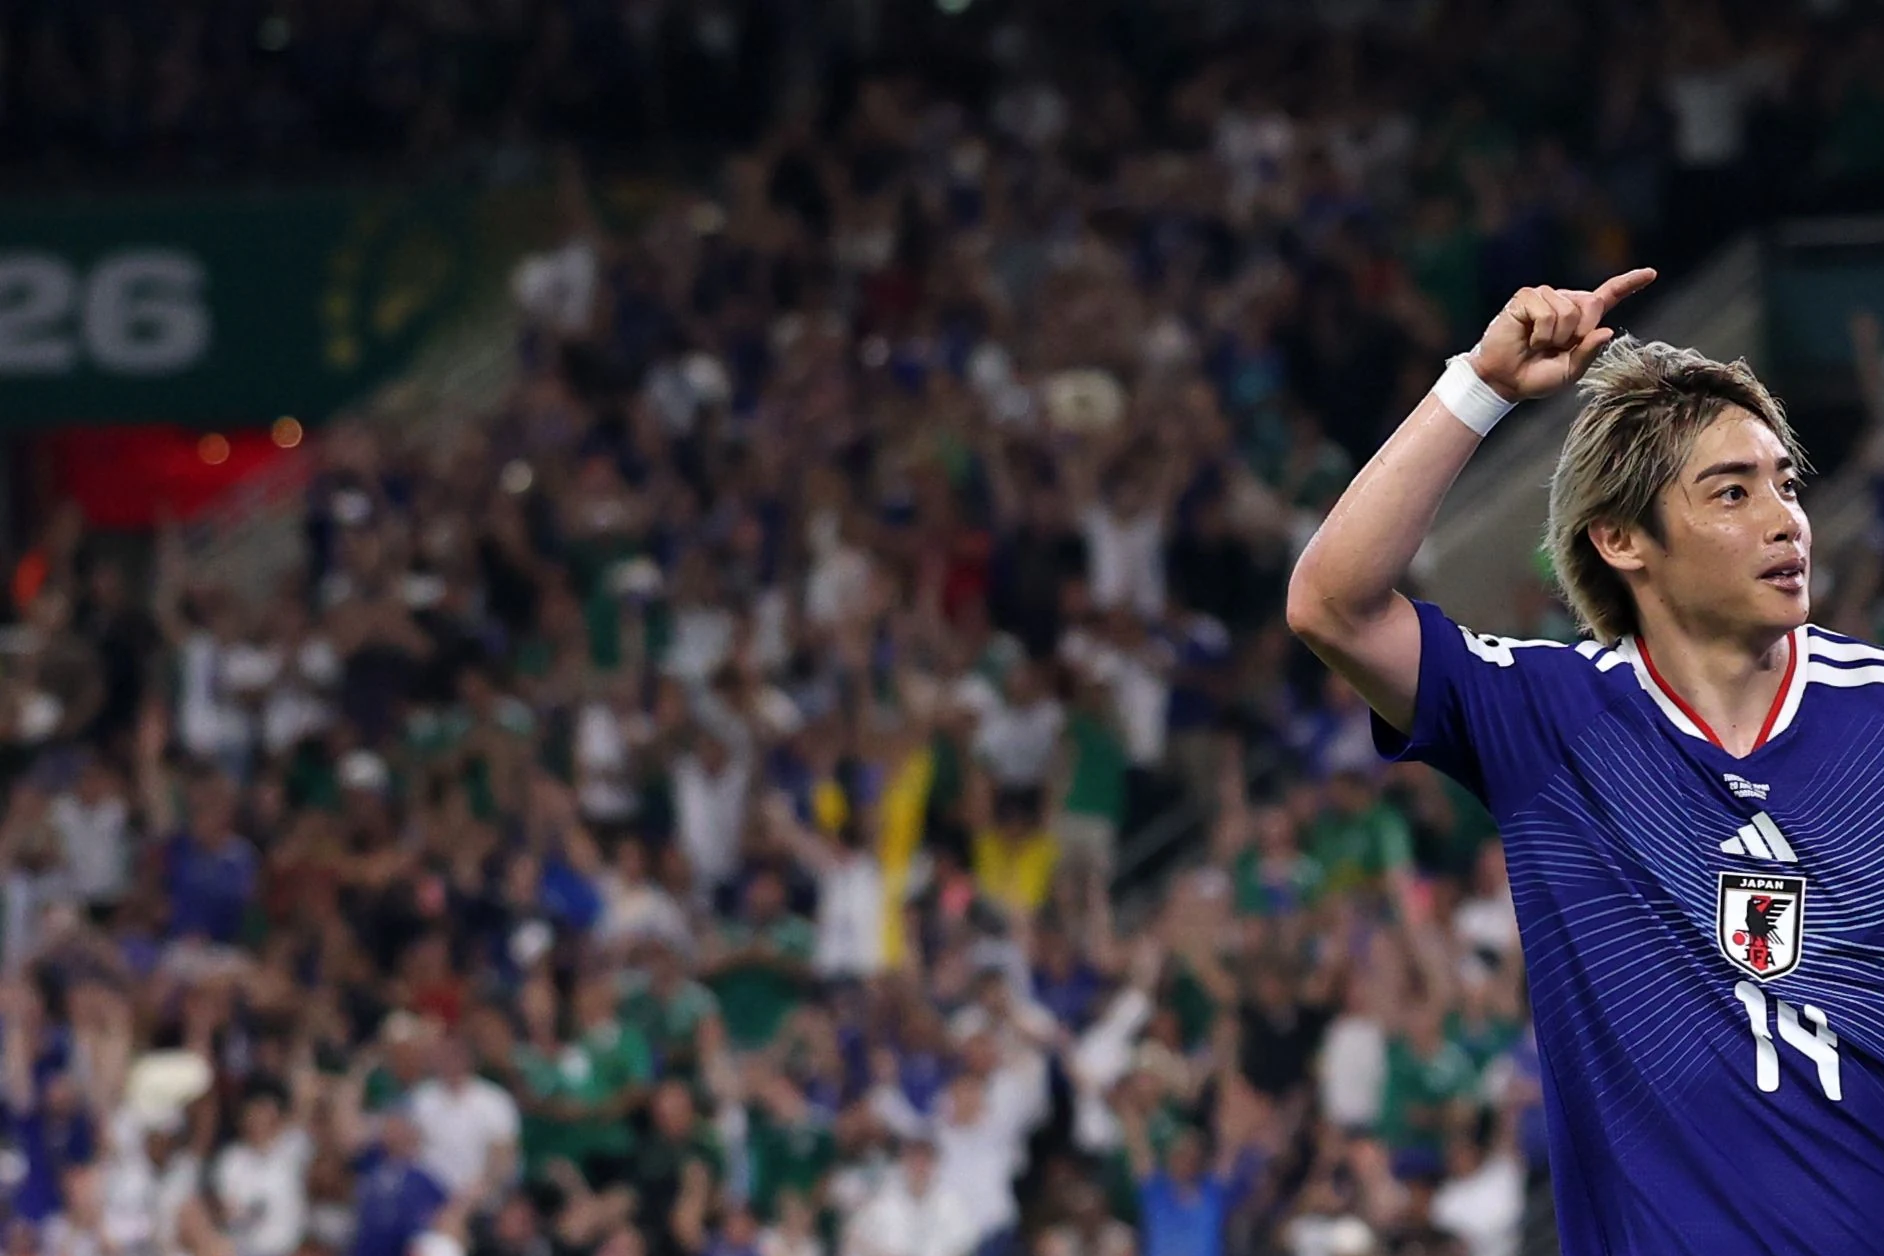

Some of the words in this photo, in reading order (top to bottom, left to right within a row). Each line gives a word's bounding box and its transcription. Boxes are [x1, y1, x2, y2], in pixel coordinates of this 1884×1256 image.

[1740, 879, 1784, 890] JAPAN
[1742, 948, 1776, 967] JFA
[1734, 980, 1842, 1101] 14
